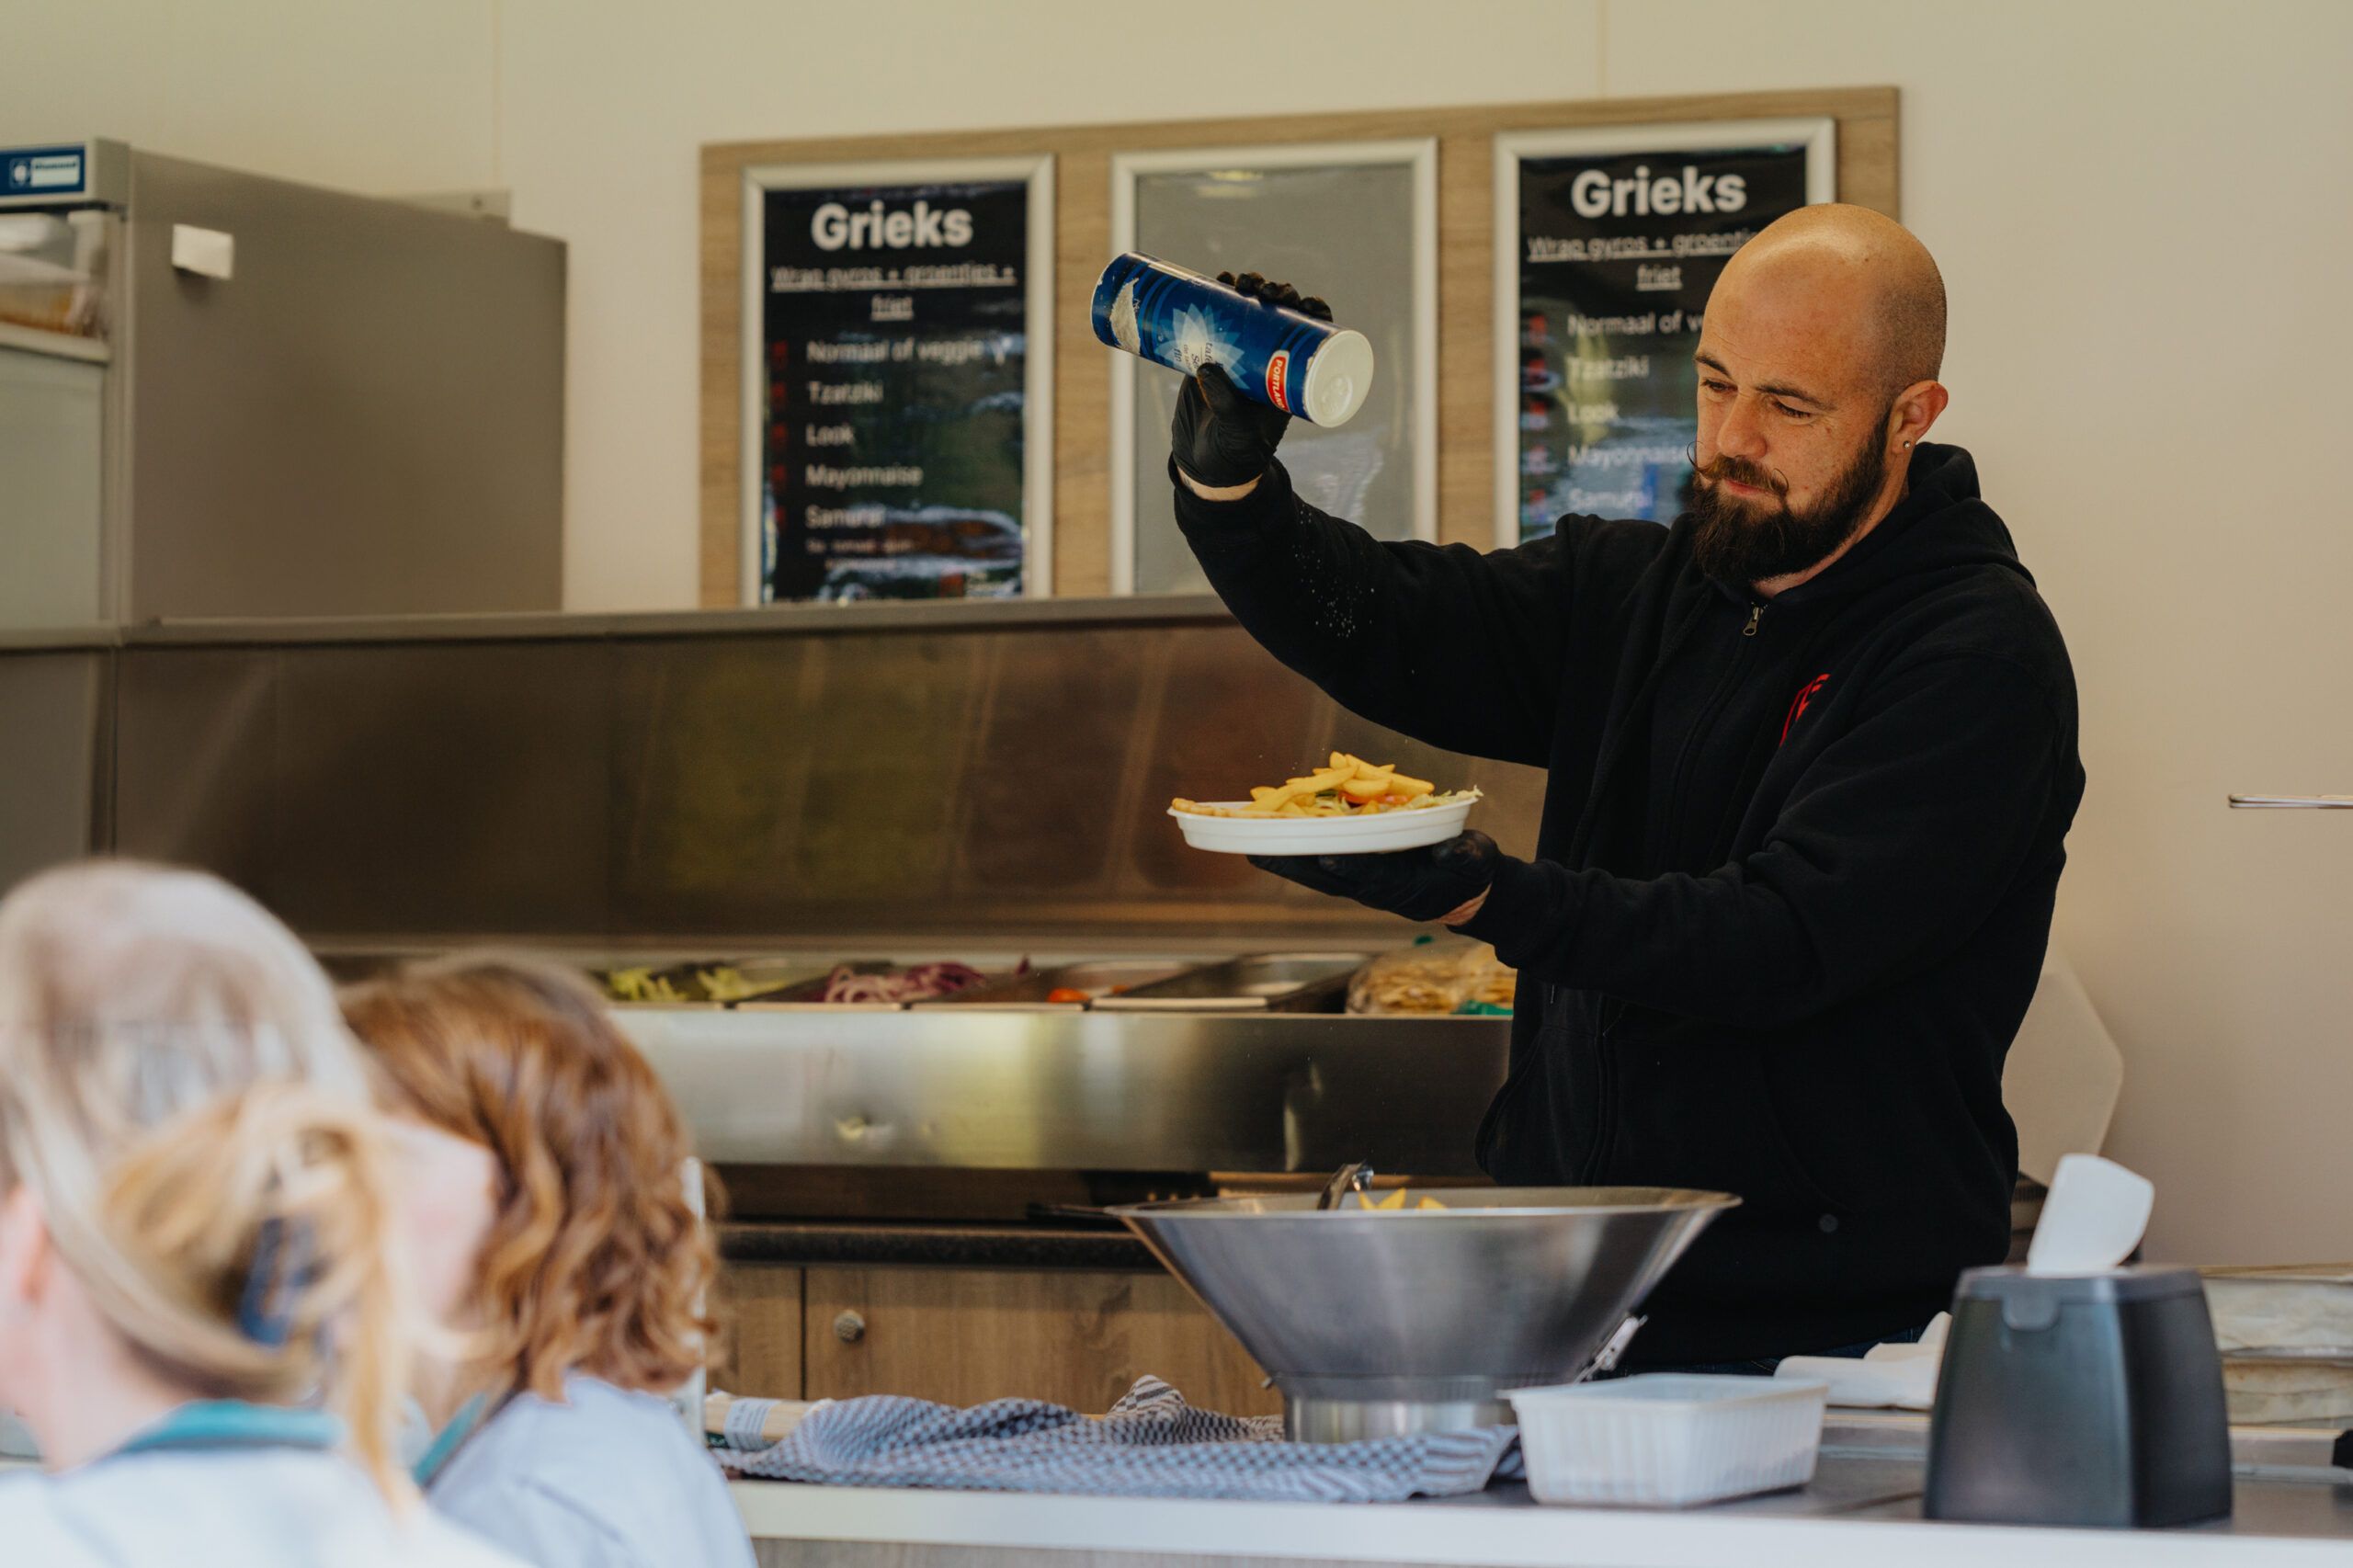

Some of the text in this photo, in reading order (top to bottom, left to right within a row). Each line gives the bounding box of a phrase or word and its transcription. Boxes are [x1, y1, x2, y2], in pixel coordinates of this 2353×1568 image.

[1570, 165, 1747, 219] Grieks
[811, 199, 973, 251] Grieks
[1587, 235, 1648, 262] gyros
[1636, 264, 1683, 291] friet
[1567, 312, 1655, 335] Normaal
[1659, 310, 1683, 334] of
[806, 337, 984, 366] Normaal of veggie
[805, 462, 924, 490] Mayonnaise
